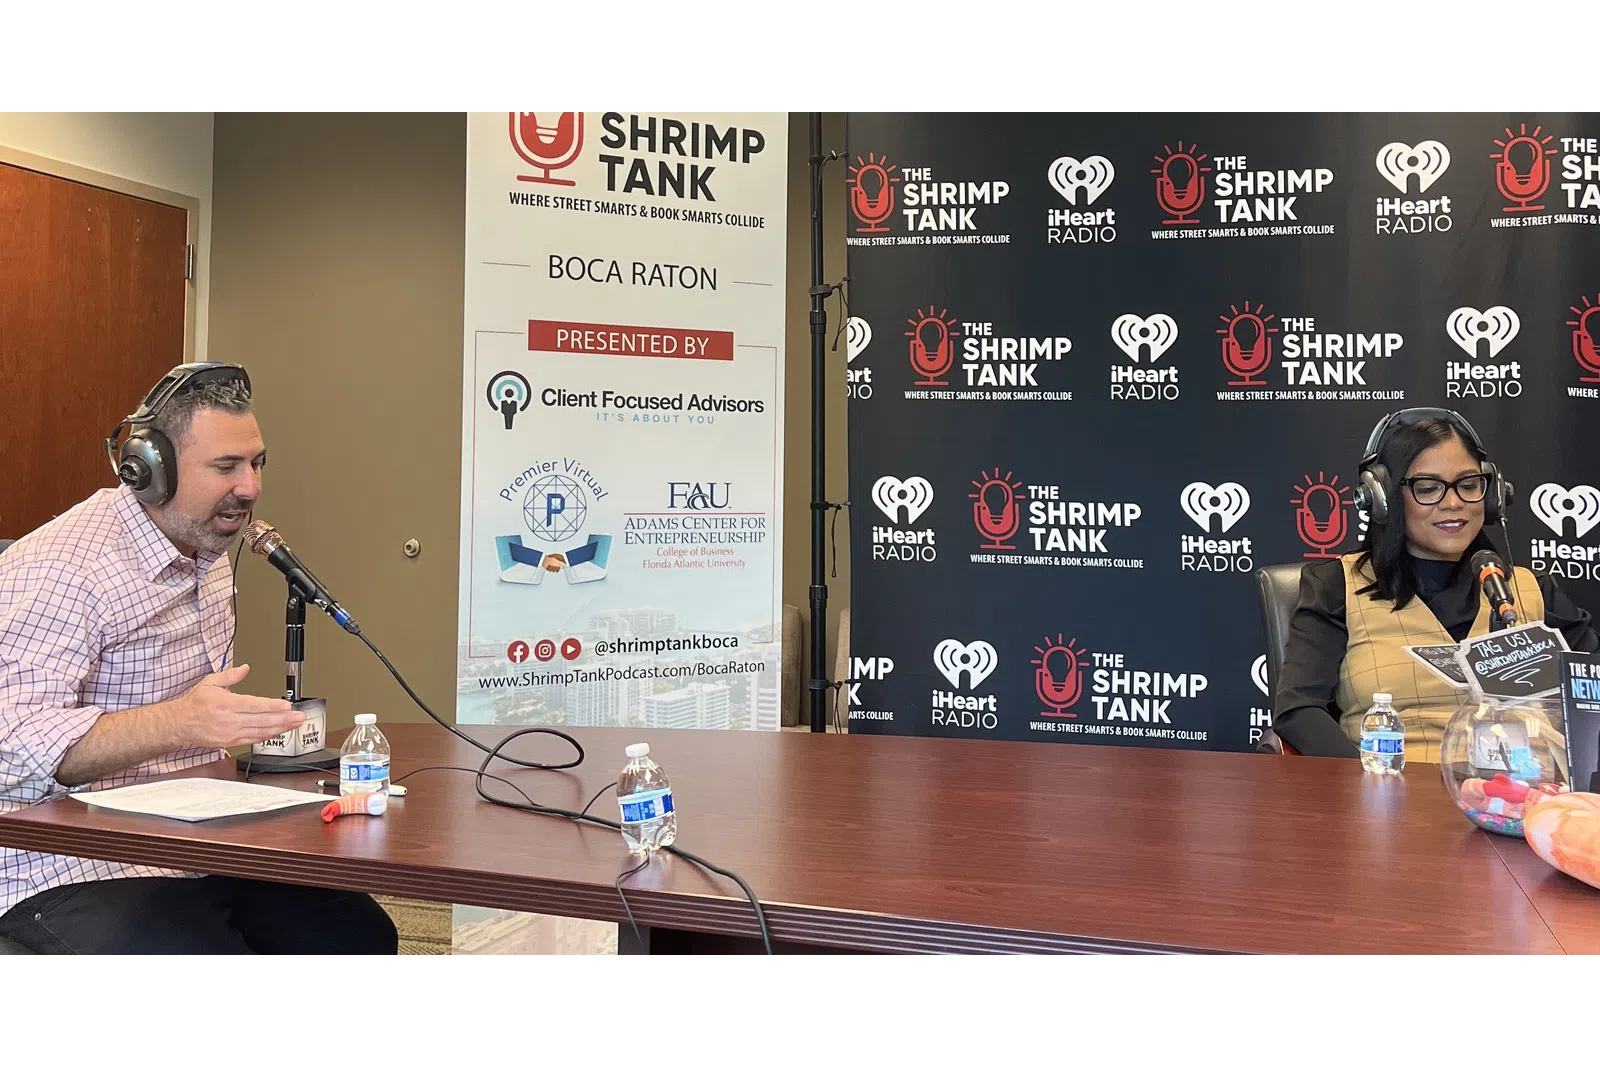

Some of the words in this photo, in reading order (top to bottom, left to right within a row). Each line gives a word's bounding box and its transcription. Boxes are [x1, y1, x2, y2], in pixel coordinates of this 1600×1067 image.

[600, 112, 766, 164] SHRIMP
[1560, 138, 1597, 153] THE
[1214, 156, 1246, 171] THE
[599, 154, 716, 202] TANK
[902, 168, 931, 181] THE
[1215, 169, 1334, 196] SHRIMP
[903, 181, 1010, 206] SHRIMP
[509, 192, 550, 208] WHERE
[553, 196, 591, 212] STREET
[594, 201, 637, 216] SMARTS
[640, 206, 648, 217] &
[651, 206, 680, 221] BOOK
[682, 210, 723, 225] SMARTS
[725, 214, 764, 228] COLLIDE
[1214, 197, 1298, 223] TANK
[1376, 196, 1451, 217] iHeart
[903, 207, 977, 231] TANK
[1048, 209, 1115, 227] iHeart
[1376, 215, 1452, 235] RADIO
[1491, 218, 1521, 228] WHERE
[1523, 215, 1552, 226] STREET
[1554, 214, 1588, 224] SMARTS
[1590, 215, 1597, 224] &
[847, 237, 870, 246] WHERE
[872, 237, 896, 246] STREET
[897, 236, 924, 245] SMARTS
[926, 236, 931, 244] &
[932, 236, 951, 244] BOOK
[953, 236, 980, 244] SMARTS
[982, 235, 1010, 244] COLLIDE
[1048, 227, 1116, 244] RADIO
[1152, 230, 1178, 239] WHERE
[1180, 229, 1206, 239] STREET
[1208, 228, 1238, 238] SMARTS
[1240, 228, 1246, 237] &
[1248, 227, 1269, 236] BOOK
[1270, 226, 1302, 236] SMARTS
[1303, 225, 1334, 234] COLLIDE
[549, 255, 623, 284] BOCA
[632, 262, 717, 291] RATON
[962, 323, 992, 336] THE
[1281, 318, 1315, 332] THE
[557, 329, 677, 354] PRESENTED
[685, 337, 709, 356] BY
[963, 337, 1072, 361] SHRIMP
[1282, 333, 1404, 358] SHRIMP
[962, 364, 1038, 387] TANK
[1111, 365, 1178, 383] iHeart
[1282, 361, 1366, 386] TANK
[1447, 362, 1520, 380] iHeart
[905, 391, 929, 400] WHERE
[930, 391, 955, 400] STREET
[956, 391, 984, 400] SMARTS
[985, 392, 991, 400] &
[992, 392, 1012, 400] BOOK
[1013, 391, 1042, 400] SMARTS
[1043, 391, 1072, 400] COLLIDE
[1111, 383, 1179, 400] RADIO
[1217, 392, 1244, 400] WHERE
[1246, 392, 1273, 400] STREET
[1275, 391, 1307, 400] SMARTS
[1308, 391, 1314, 400] &
[1316, 391, 1337, 400] BOOK
[1338, 390, 1371, 400] SMARTS
[1372, 390, 1404, 400] COLLIDE
[1447, 381, 1522, 398] RADIO
[1567, 387, 1598, 398] WHERE
[541, 388, 597, 407] Client
[602, 391, 682, 410] Focused
[688, 394, 764, 413] Advisors
[597, 413, 624, 422] IT'S
[633, 414, 680, 423] ABOUT
[688, 415, 714, 424] YOU
[500, 459, 557, 501] Premier
[563, 458, 608, 502] Virtual
[667, 482, 732, 510] FAU
[1028, 486, 1059, 500] THE
[624, 517, 679, 530] ADAMS
[682, 516, 738, 530] CENTER
[741, 518, 766, 528] FOR
[1029, 500, 1142, 527] SHRIMP
[624, 532, 766, 545] ENTREPRENEURSHIP
[873, 526, 935, 545] iHeart
[1029, 527, 1108, 552] TANK
[1181, 535, 1251, 555] iHeart
[656, 547, 688, 558] College
[690, 547, 699, 556] of
[701, 548, 734, 556] Business
[873, 545, 936, 562] RADIO
[1531, 539, 1600, 561] iHear
[643, 559, 672, 568] Florida
[674, 559, 704, 568] Atlantic
[707, 558, 746, 569] University
[970, 554, 996, 564] WHERE
[997, 555, 1023, 564] STREET
[1024, 556, 1052, 565] SMARTS
[1054, 557, 1060, 565] &
[1062, 557, 1082, 566] BOOK
[1083, 558, 1112, 567] SMARTS
[1114, 558, 1143, 568] COLLIDE
[1182, 555, 1253, 573] RADIO
[595, 635, 738, 657] @shrimptankboca
[1472, 640, 1502, 658] TAG
[1505, 632, 1532, 648] US!
[1092, 653, 1124, 668] THE
[1569, 662, 1587, 677] THE
[479, 661, 765, 689] www.ShrimpTankPodcast.com/BocaRaton
[1092, 669, 1208, 698] SHRIMP
[933, 690, 997, 712] iHeart
[1092, 696, 1172, 724] TANK
[867, 712, 894, 721] COLLIDE
[932, 709, 998, 730] RADIO
[1030, 721, 1056, 732] WHERE
[1057, 723, 1083, 733] STREET
[1085, 725, 1114, 735] SMARTS
[1116, 726, 1122, 736] &
[1123, 727, 1144, 737] BOOK
[1145, 728, 1175, 739] SMARTS
[1177, 730, 1207, 741] COLLIDE
[303, 736, 319, 746] TANK
